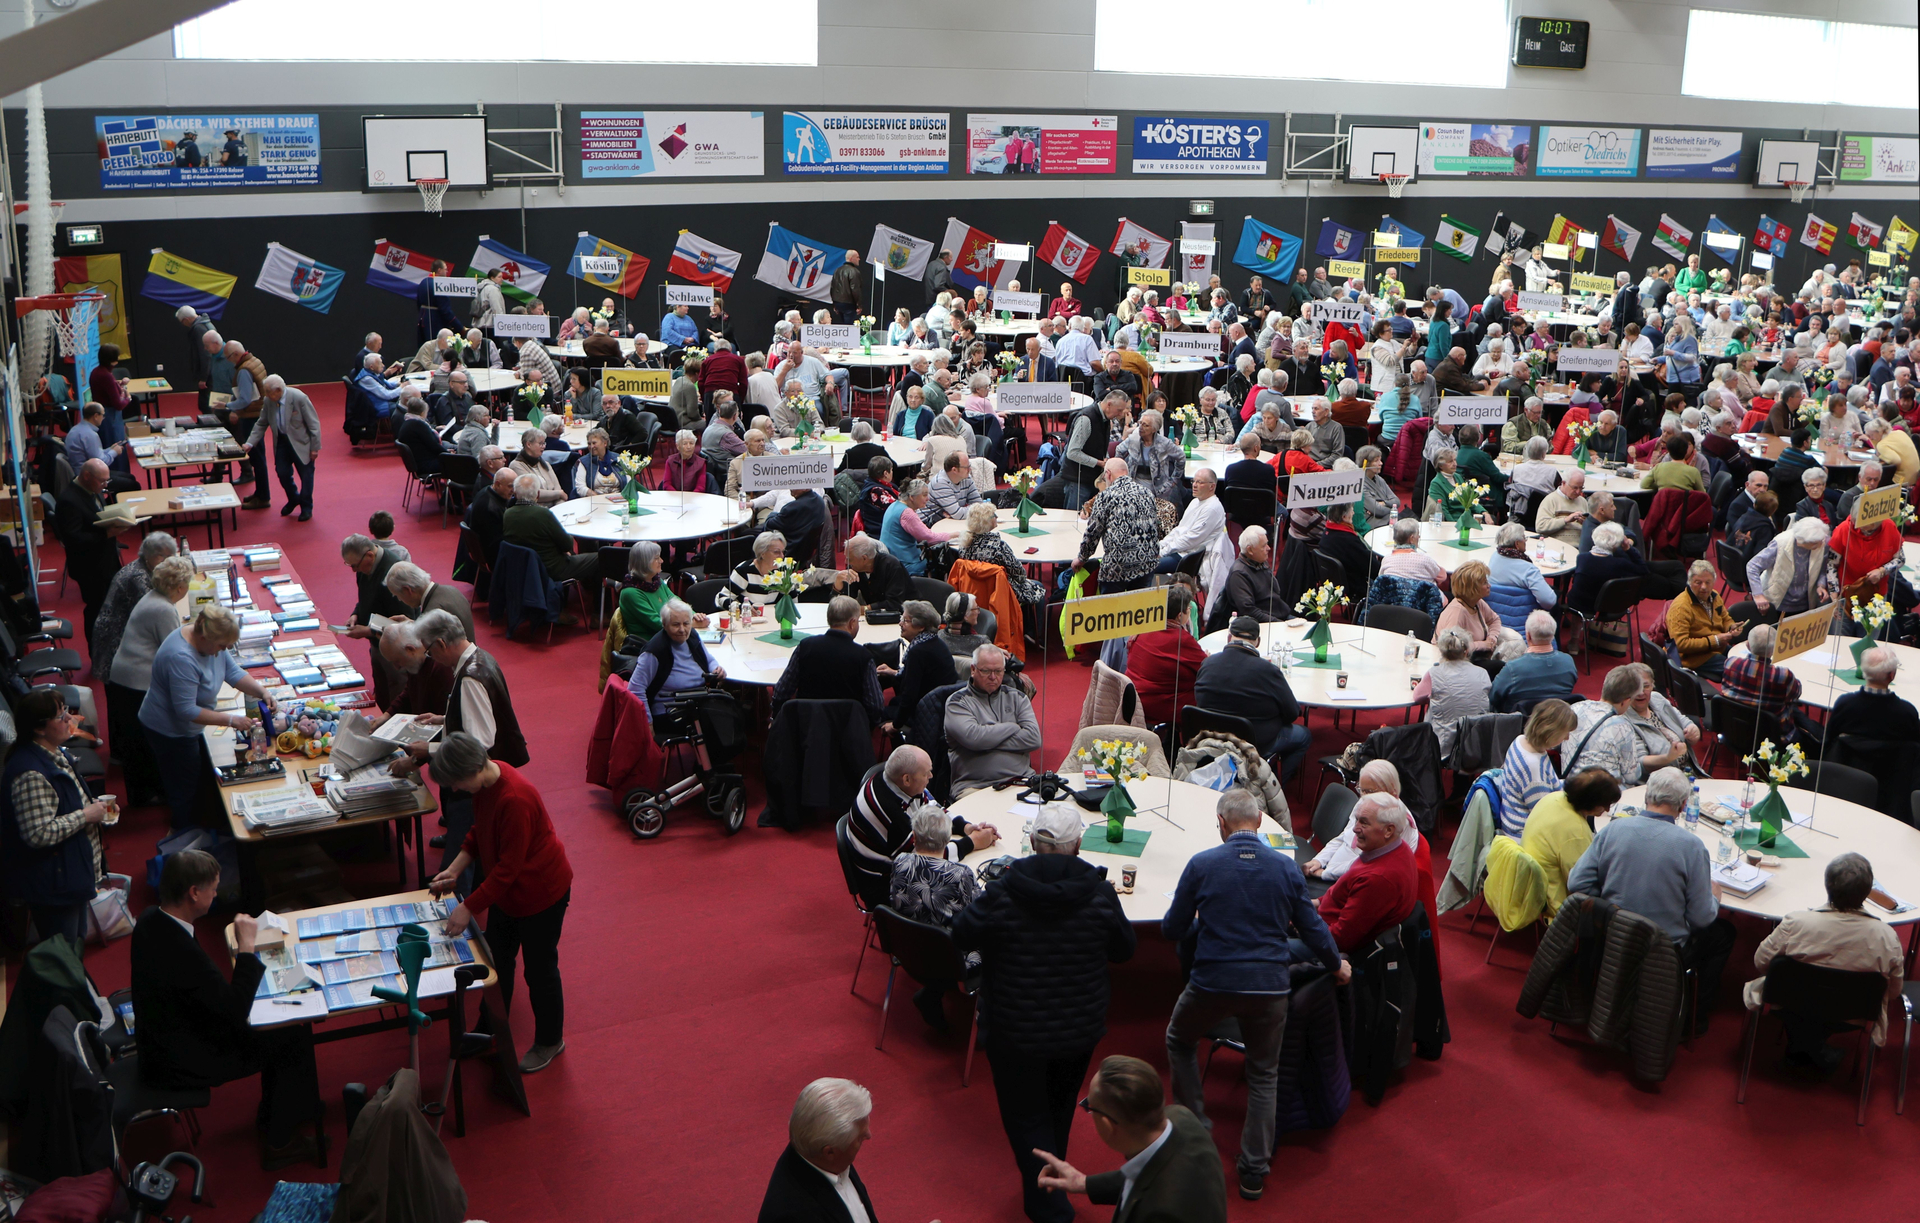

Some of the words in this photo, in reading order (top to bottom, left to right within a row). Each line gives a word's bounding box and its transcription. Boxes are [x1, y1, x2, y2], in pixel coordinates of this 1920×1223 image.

[1540, 21, 1571, 34] 10:07
[159, 117, 205, 129] DÄCHER.
[208, 119, 230, 129] WIR
[234, 118, 275, 129] STEHEN
[278, 117, 317, 128] DRAUF.
[824, 116, 906, 130] GEBÄUDESERVICE
[910, 117, 946, 130] BRÜSCH
[1548, 138, 1582, 155] Optiker
[1664, 136, 1695, 145] Sicherheit
[1708, 137, 1722, 147] Play.
[591, 151, 638, 159] STADTWÄRME
[839, 148, 859, 156] 03971
[860, 148, 885, 156] 833066
[899, 148, 946, 158] gsb-anklam.de
[1178, 146, 1240, 158] APOTHEKEN
[1583, 144, 1627, 160] Diedrichs
[103, 151, 174, 170] PEENE-NORD
[588, 164, 640, 172] gwa-anklam.de
[788, 165, 834, 173] Gebäudereinigung
[840, 164, 892, 172] Facility-Management
[1182, 243, 1212, 251] Neustettin
[1378, 251, 1418, 260] Friedeberg
[585, 260, 617, 271] Köslin
[1334, 263, 1361, 275] Reetz
[1134, 272, 1162, 284] Stolp
[435, 282, 476, 296] Kolberg
[1572, 278, 1611, 291] Arnswalde
[668, 291, 711, 303] Schlawe
[997, 296, 1040, 308] Rummelsburg
[1520, 296, 1560, 308] Arnswalde
[1313, 304, 1361, 320] Pyritz
[497, 321, 545, 333] Greifenberg
[807, 326, 849, 339] Belgard
[1164, 338, 1219, 352] Dramburg
[1560, 356, 1612, 367] Greifenhagen
[606, 376, 668, 392] Cammin
[1000, 393, 1062, 405] Regenwalde
[1447, 405, 1502, 420] Stargard
[753, 461, 827, 476] Swinemünde
[774, 478, 826, 486] Usedom-Wollin
[1293, 478, 1363, 501] Naugard
[1862, 495, 1897, 520] Saatzig
[1071, 604, 1164, 635] Pommern
[1778, 618, 1829, 654] Stettin
